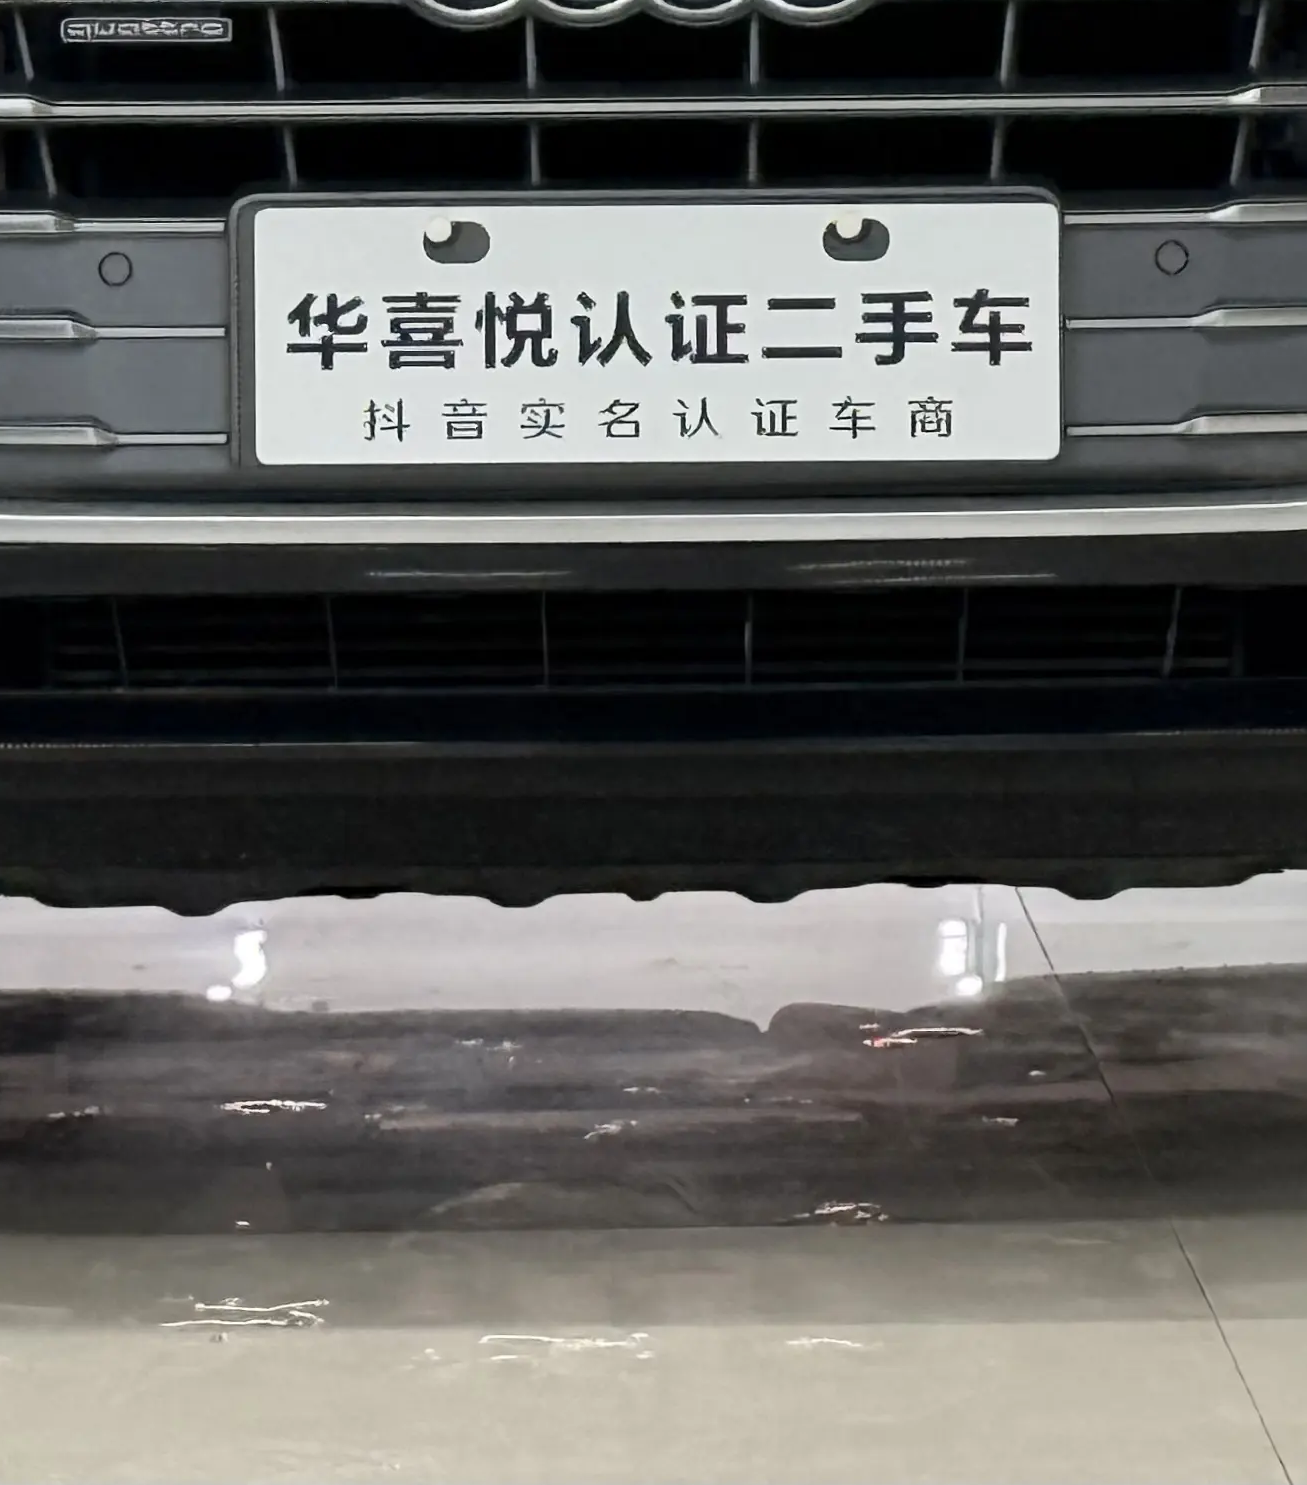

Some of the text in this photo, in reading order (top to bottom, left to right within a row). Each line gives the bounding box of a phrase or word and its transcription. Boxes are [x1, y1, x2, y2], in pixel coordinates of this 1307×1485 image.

[65, 20, 225, 41] quattro
[286, 290, 1034, 371] 华喜悦认证二手车
[363, 395, 954, 442] 抖音实名认证车商
